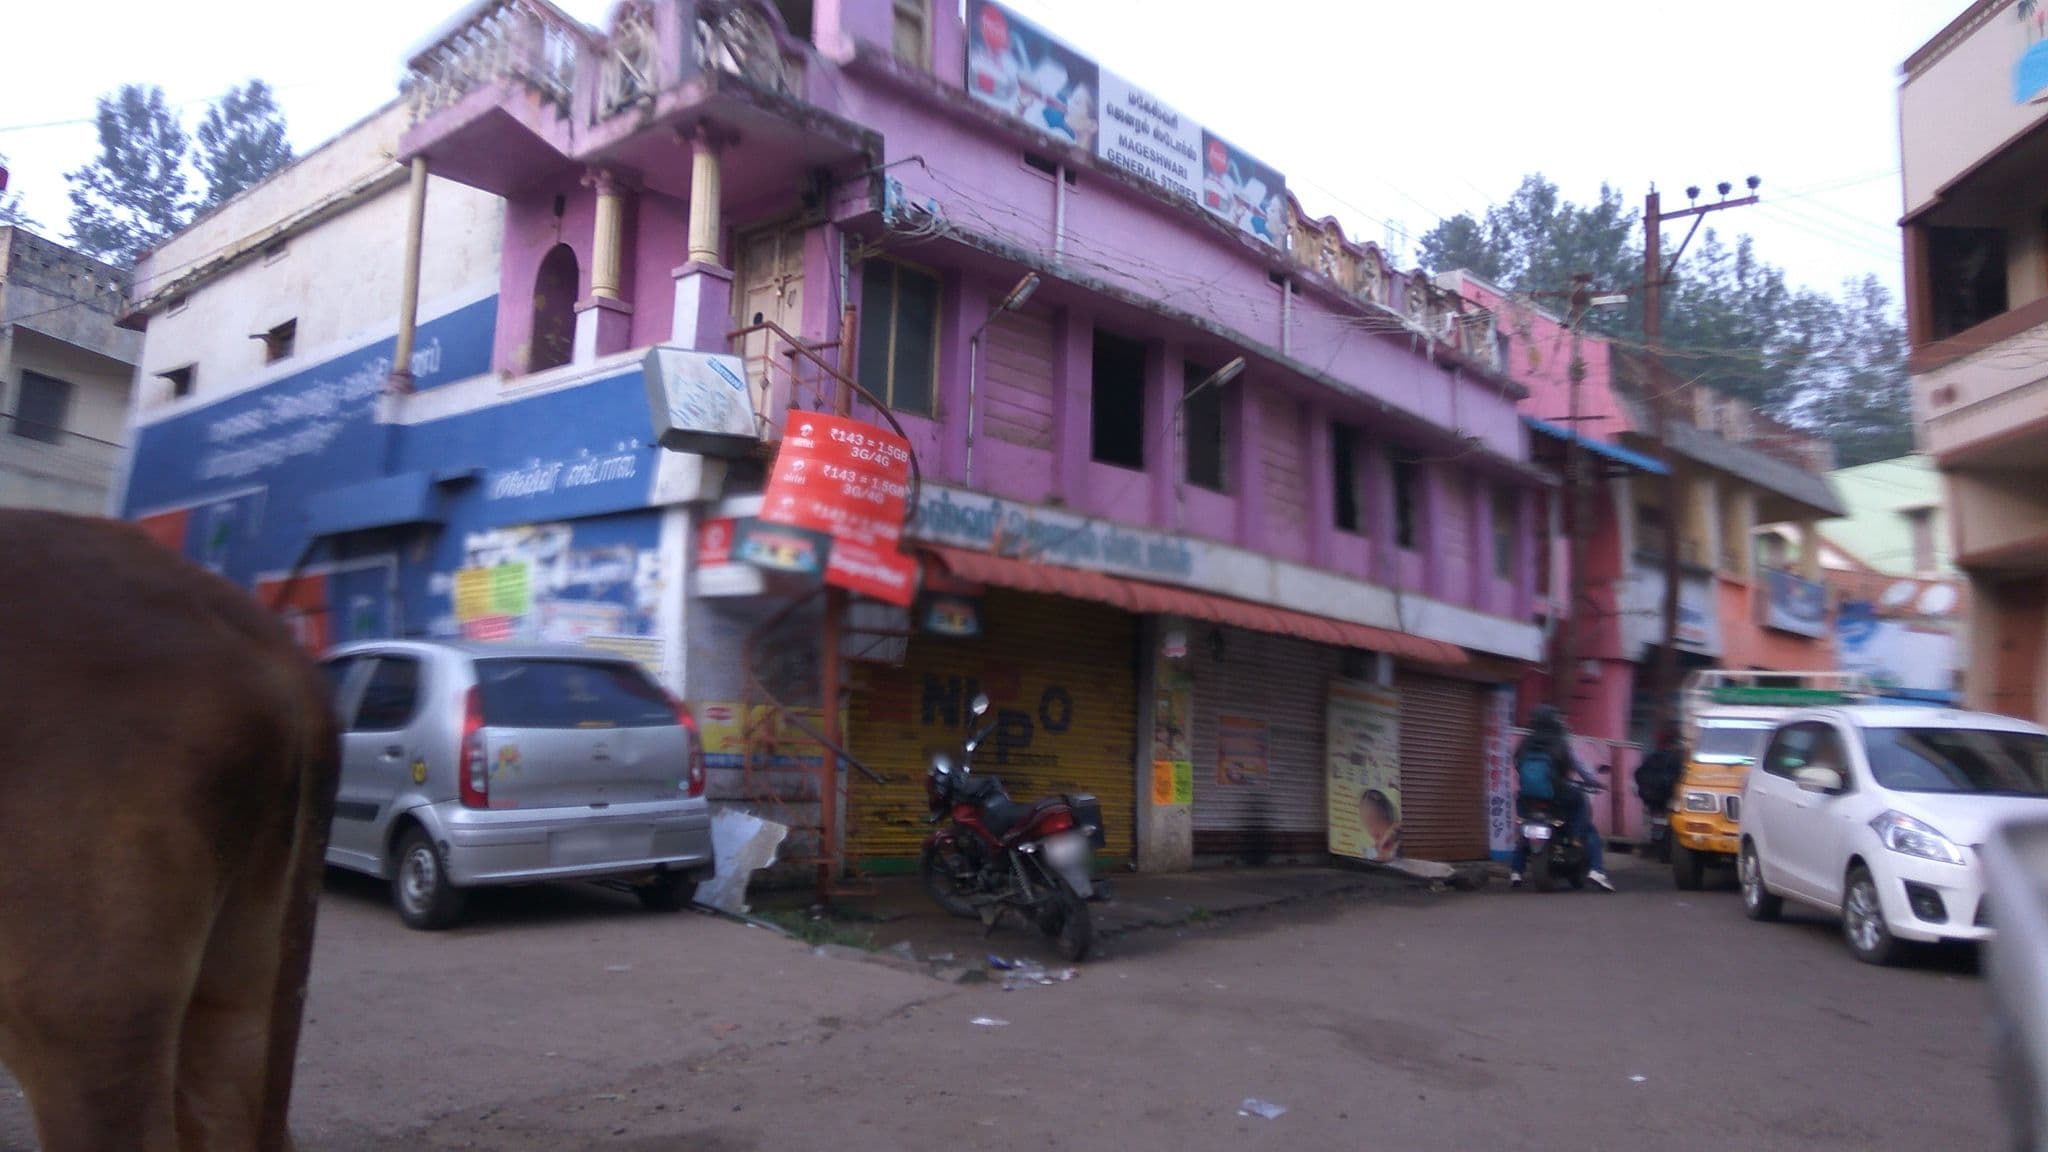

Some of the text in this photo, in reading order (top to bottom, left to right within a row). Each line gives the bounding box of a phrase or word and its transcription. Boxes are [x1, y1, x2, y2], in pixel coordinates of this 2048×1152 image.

[1119, 134, 1188, 180] MAGESHWARI
[1107, 148, 1198, 201] GENERAL STORES
[830, 428, 864, 446] ₹143
[878, 441, 909, 463] 1.5GB
[851, 447, 890, 468] 3G/4G
[783, 473, 806, 485] airtel
[823, 464, 856, 482] ₹143
[843, 484, 884, 505] 3G/4G
